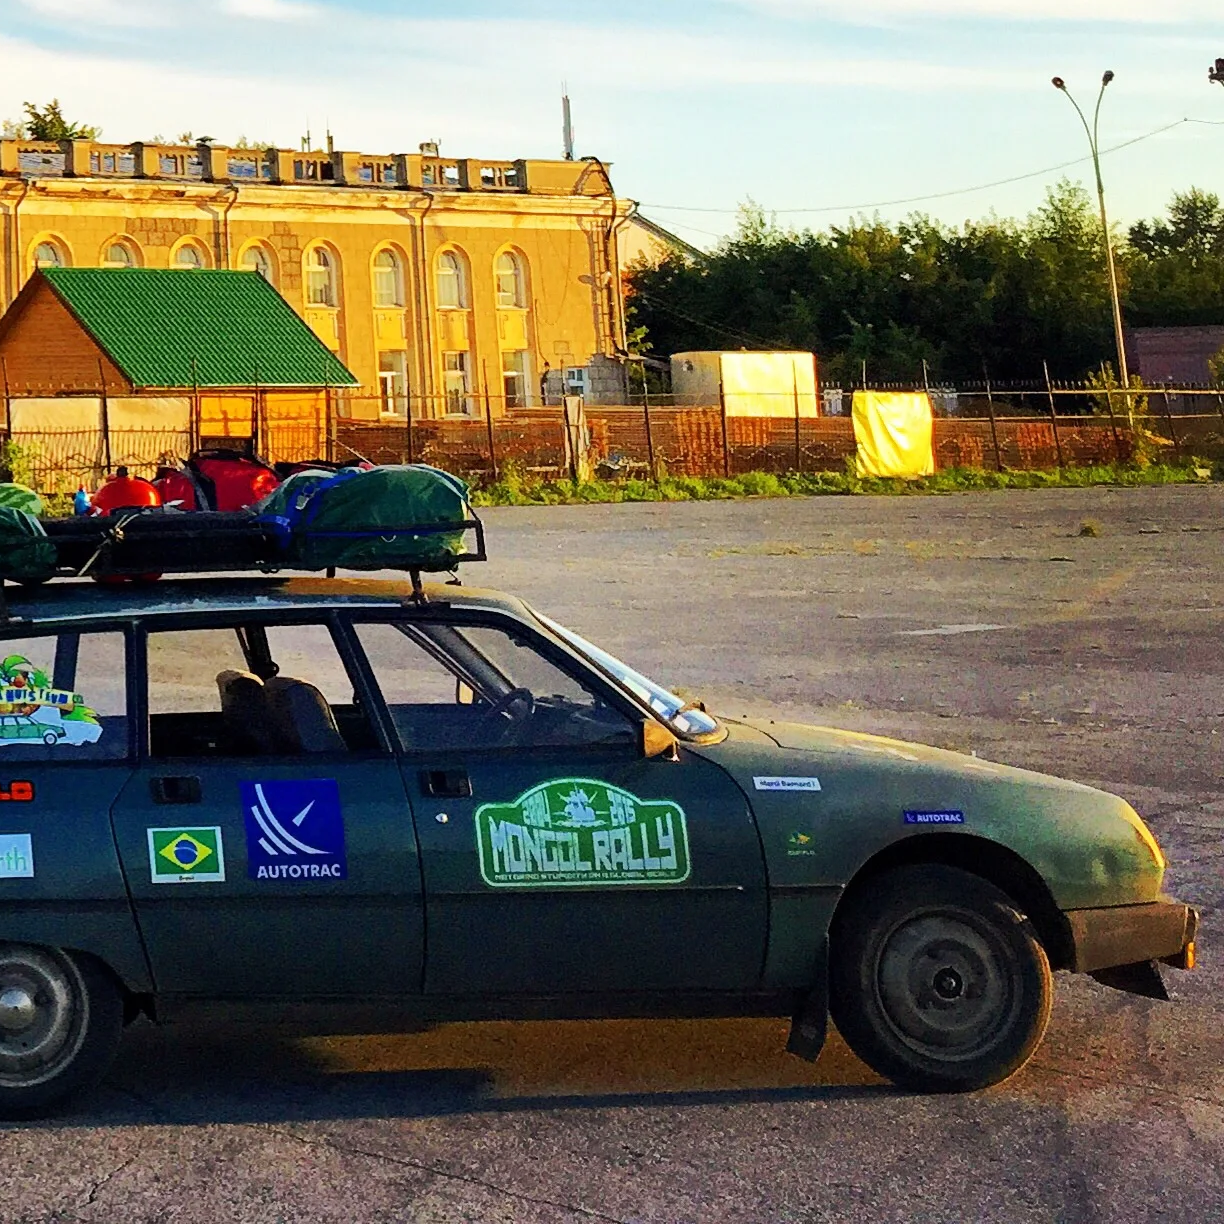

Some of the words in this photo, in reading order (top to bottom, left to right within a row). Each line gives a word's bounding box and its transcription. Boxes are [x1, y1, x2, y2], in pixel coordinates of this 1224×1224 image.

[917, 813, 962, 823] AUTOTRAC
[488, 815, 592, 873] MONGOL
[591, 811, 678, 872] RALLY
[257, 863, 341, 879] AUTOTRAC
